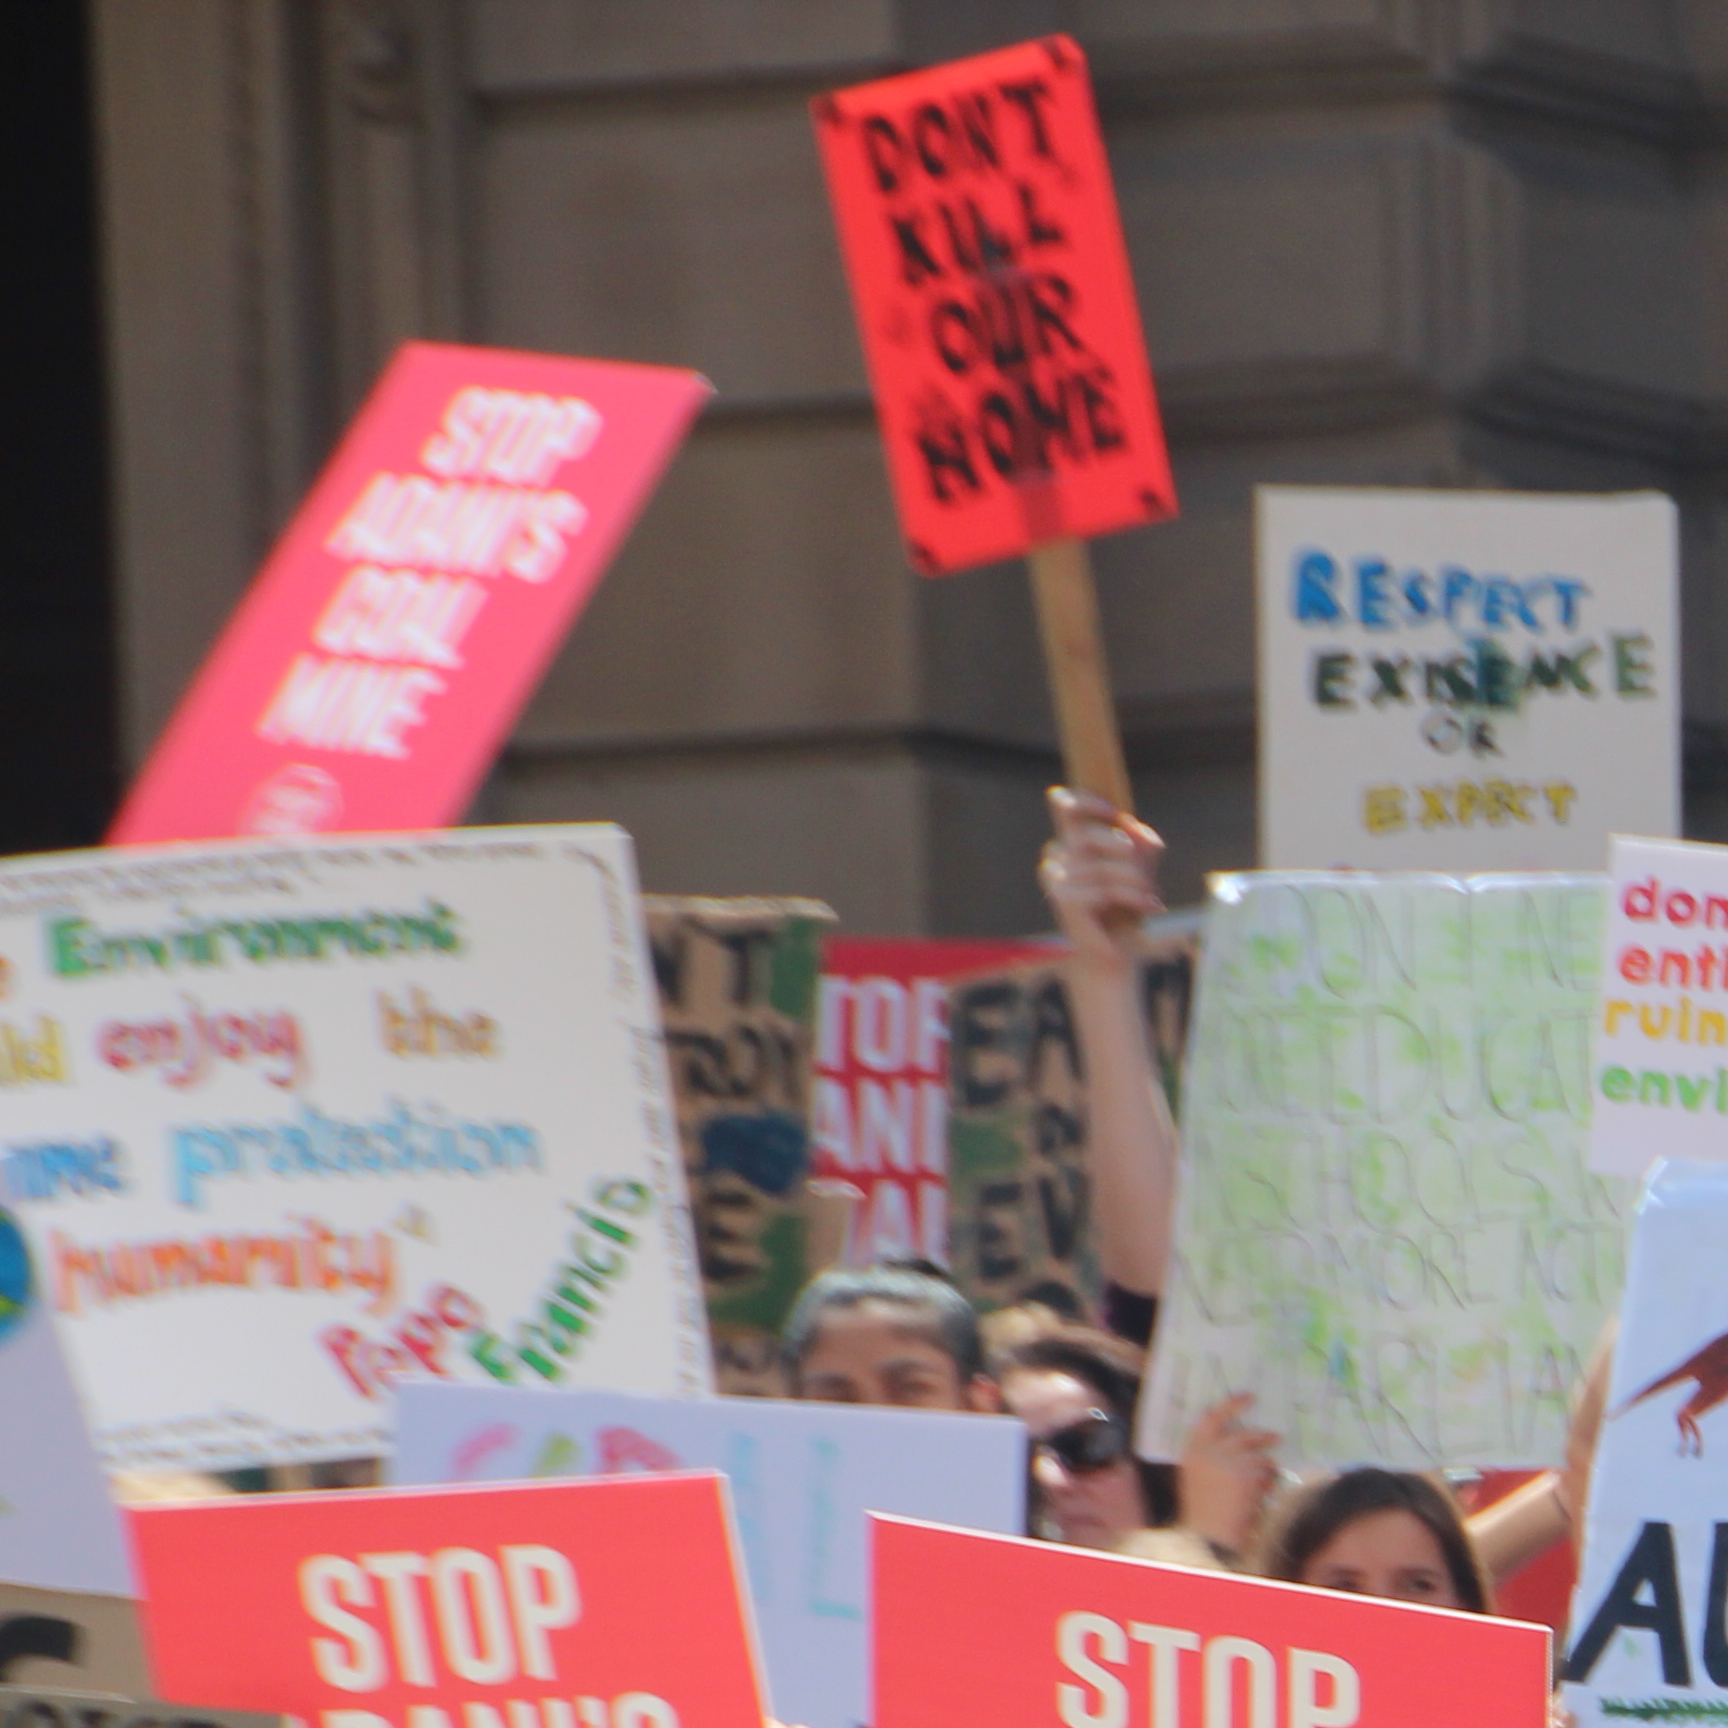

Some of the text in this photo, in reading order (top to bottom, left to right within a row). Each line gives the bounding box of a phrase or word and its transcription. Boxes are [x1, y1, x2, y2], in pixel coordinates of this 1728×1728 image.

[887, 183, 1066, 286] KILL
[930, 270, 1085, 378] OUR
[420, 384, 604, 486] STOP
[916, 360, 1128, 504] HOME
[322, 471, 589, 584] ADANI'S
[312, 563, 490, 670] COAL
[1292, 546, 1592, 632] RESPECT
[255, 653, 448, 760] MINE
[1420, 710, 1504, 760] OR
[47, 902, 466, 978] Environment
[96, 992, 308, 1091] enjoy
[373, 986, 502, 1057] the
[171, 1098, 546, 1207] protection
[299, 1541, 582, 1692] STOP
